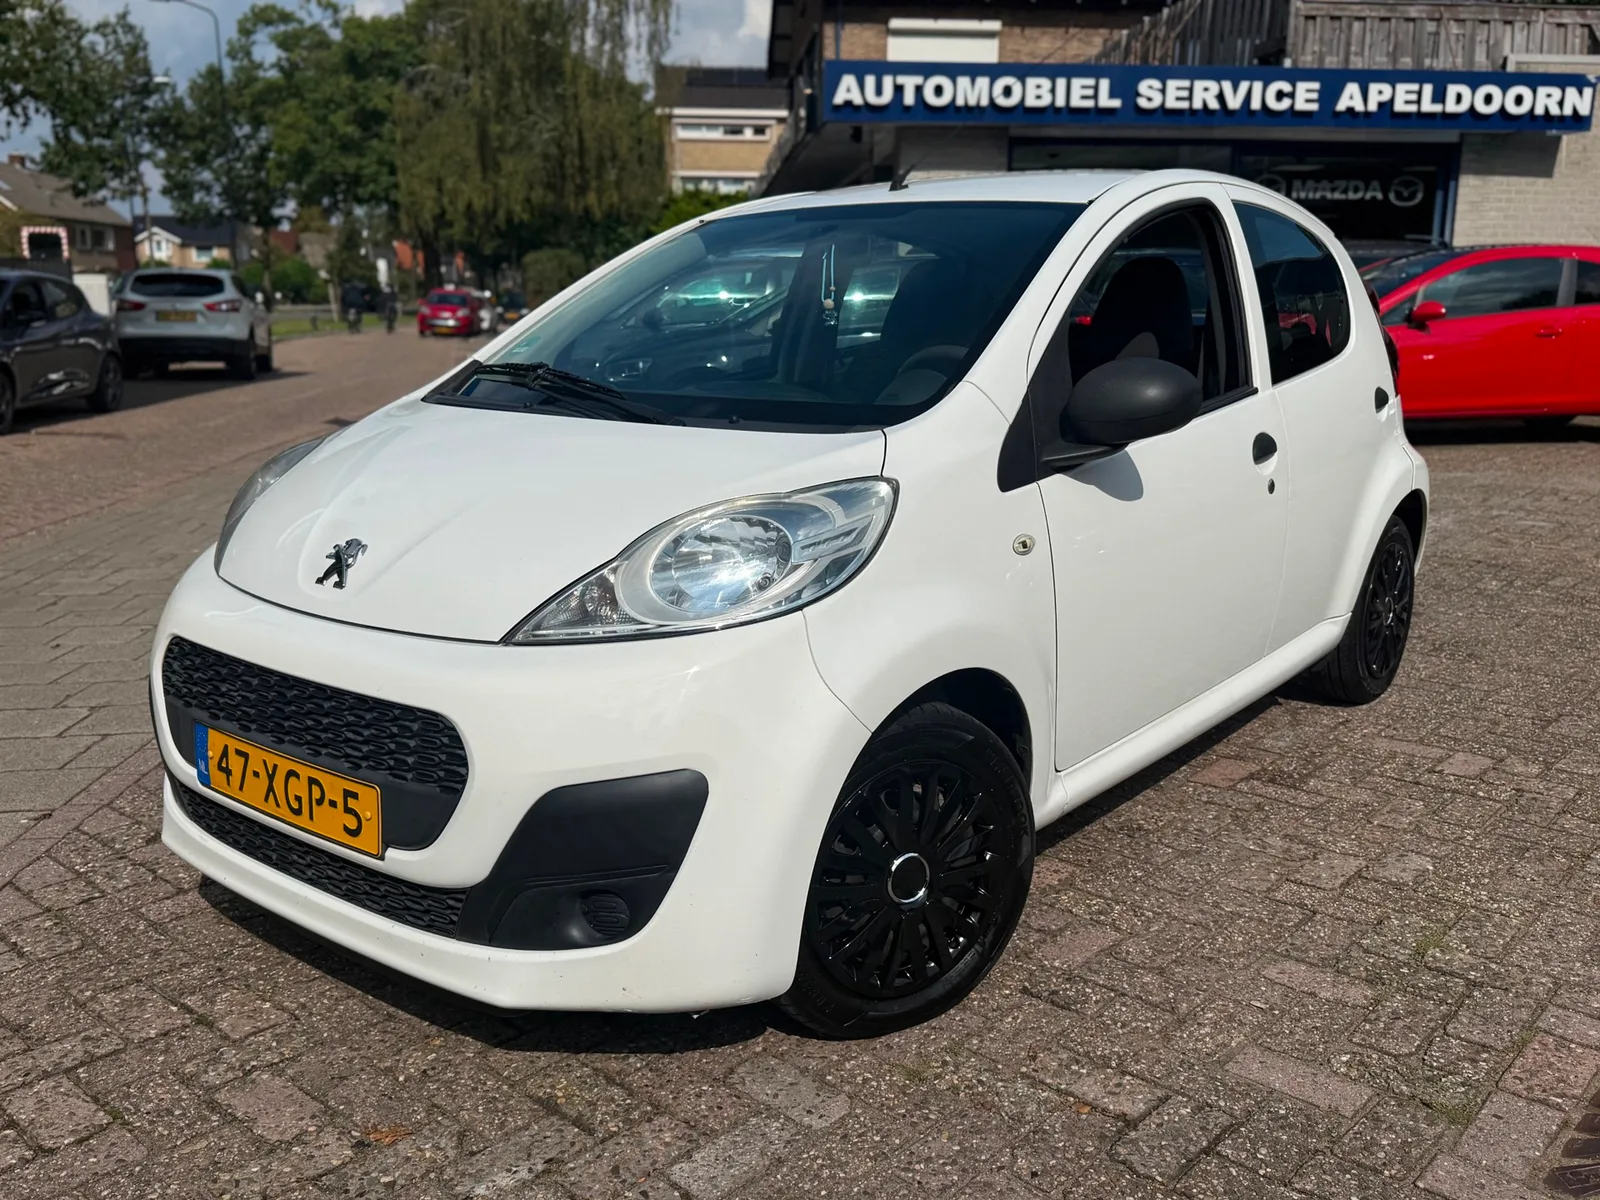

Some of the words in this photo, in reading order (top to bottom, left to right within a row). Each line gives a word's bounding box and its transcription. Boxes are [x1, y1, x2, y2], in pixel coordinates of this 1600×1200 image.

[832, 74, 1122, 108] AUTOMOBIEL
[1136, 78, 1321, 112] SERVICE
[1335, 82, 1593, 116] APELDOORN
[1291, 179, 1384, 200] MAZDA
[217, 743, 363, 838] 47-XGP-5
